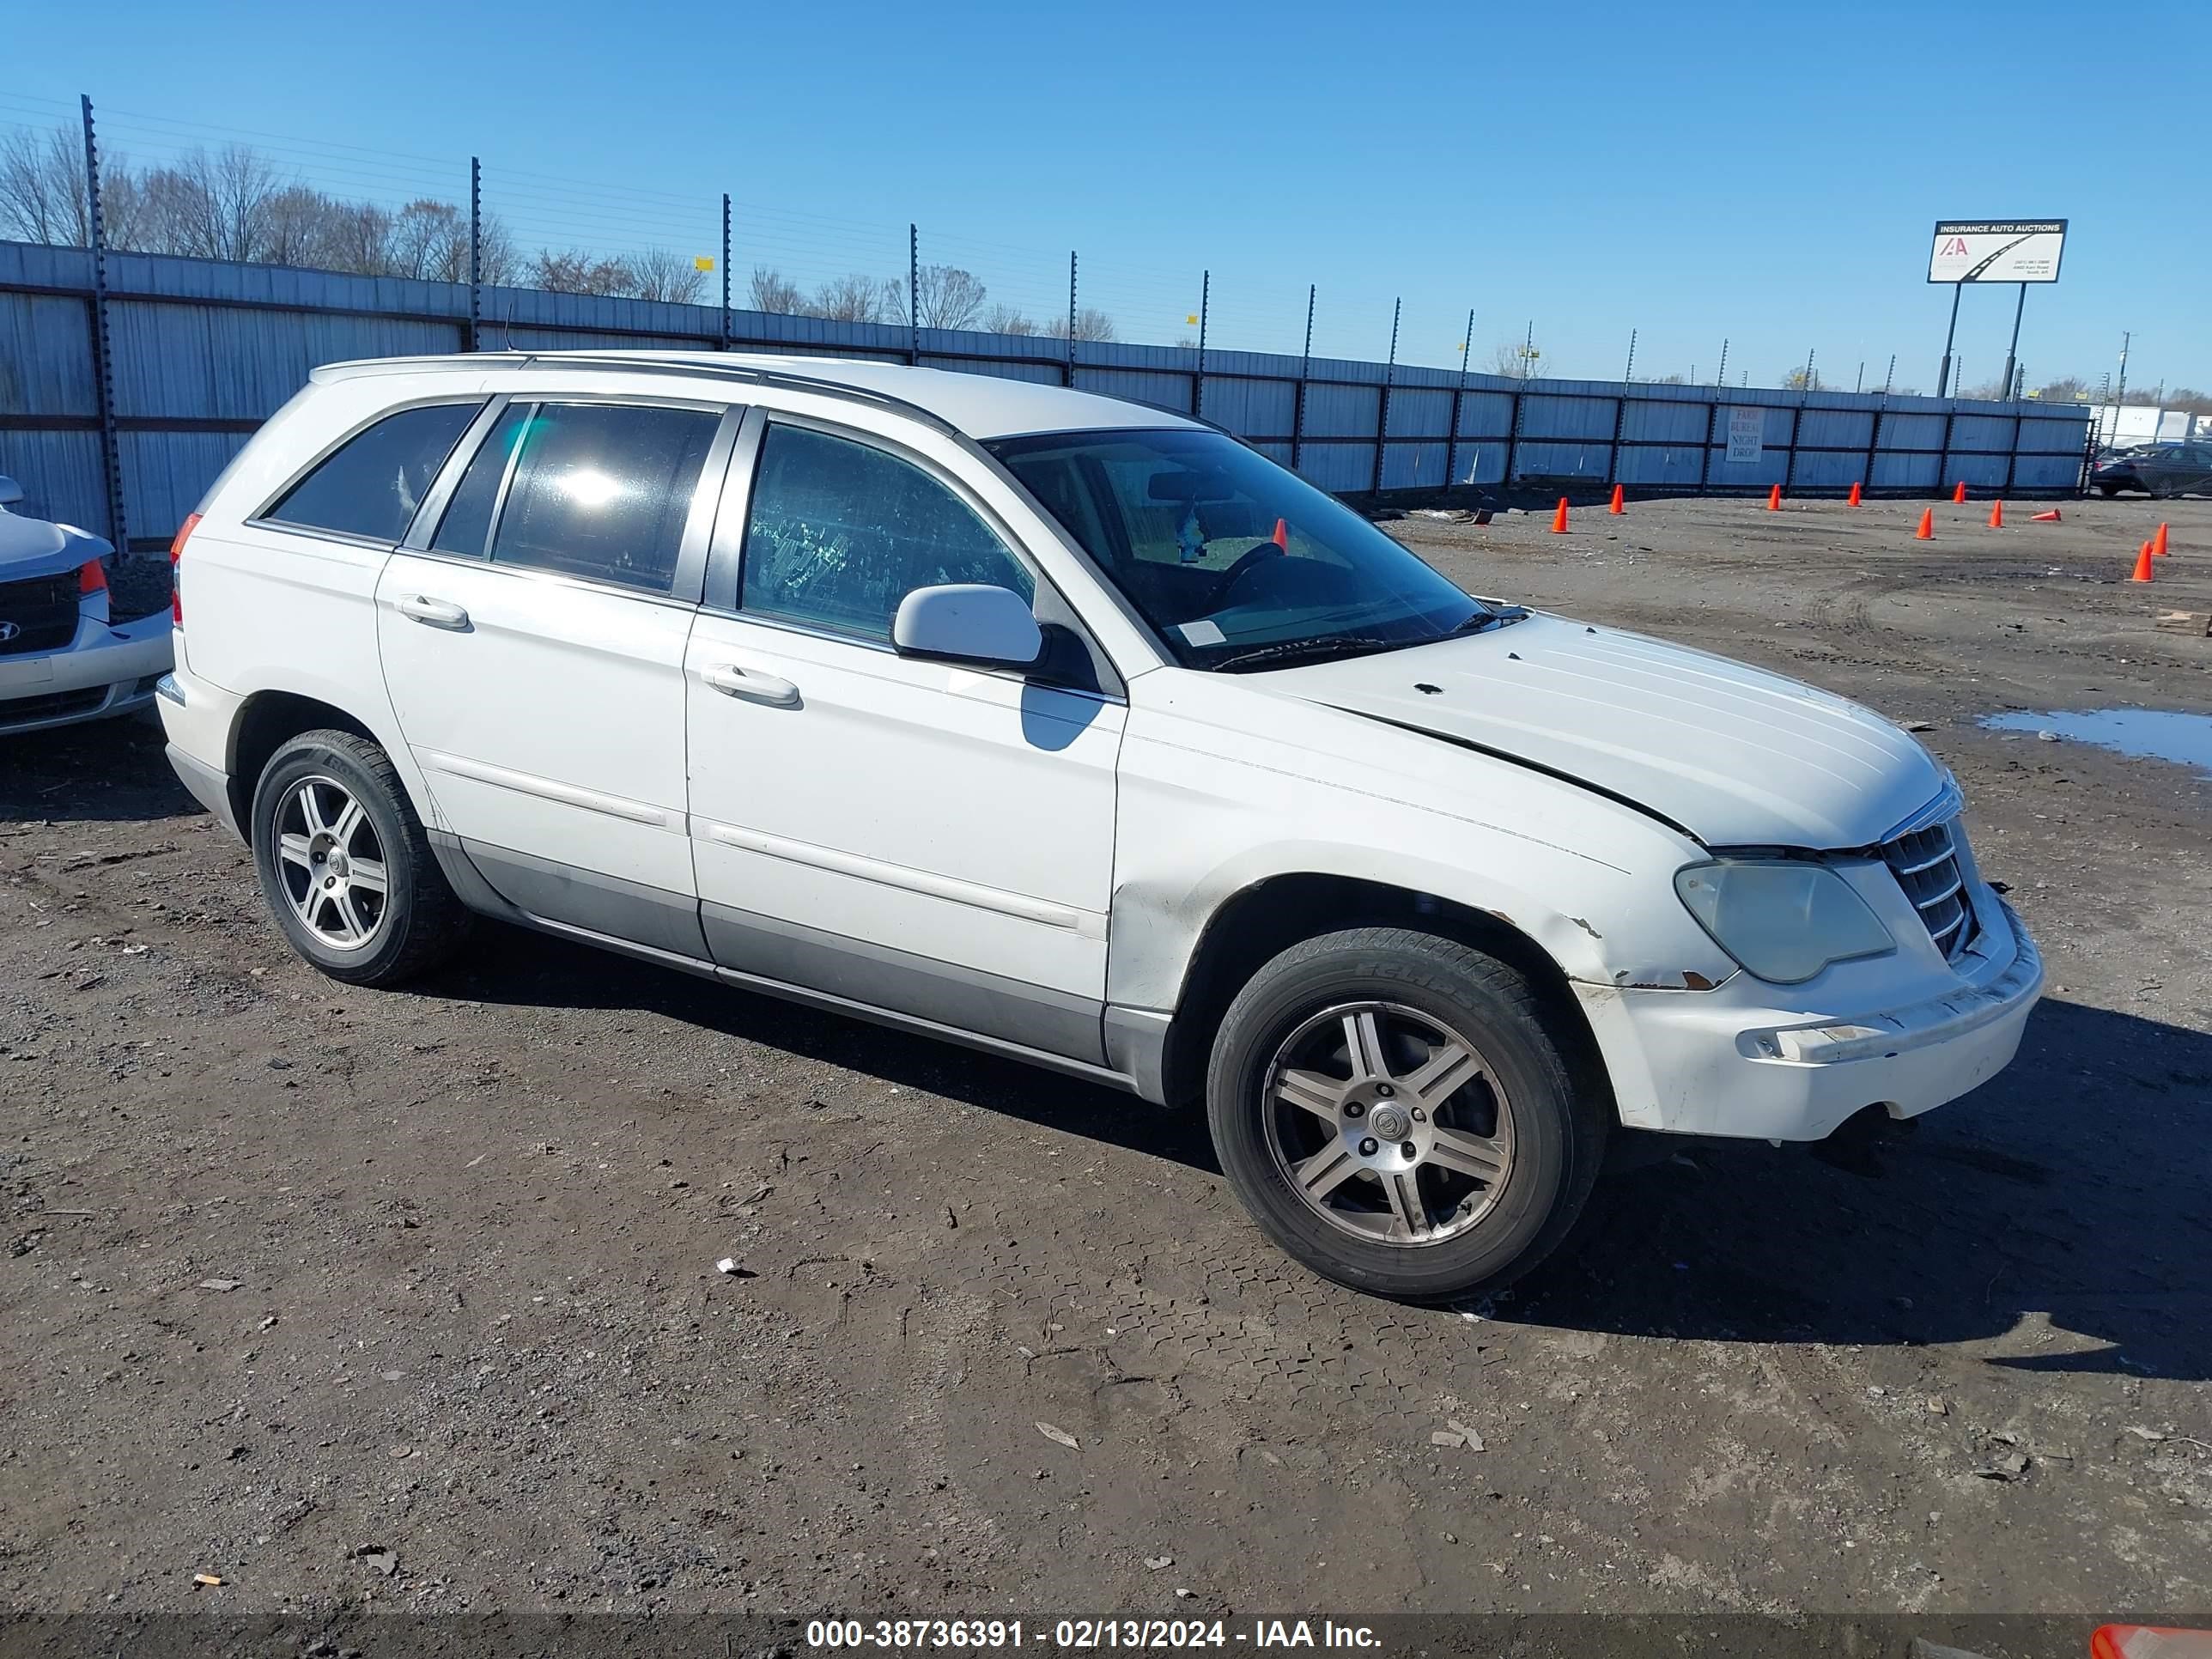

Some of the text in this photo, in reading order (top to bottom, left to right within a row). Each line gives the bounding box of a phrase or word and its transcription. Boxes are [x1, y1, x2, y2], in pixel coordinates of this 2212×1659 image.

[1940, 223, 2060, 234] INSURANCE AUTO AUCTIONS
[1731, 434, 1759, 446] NIGHT
[1733, 447, 1755, 458] DROP
